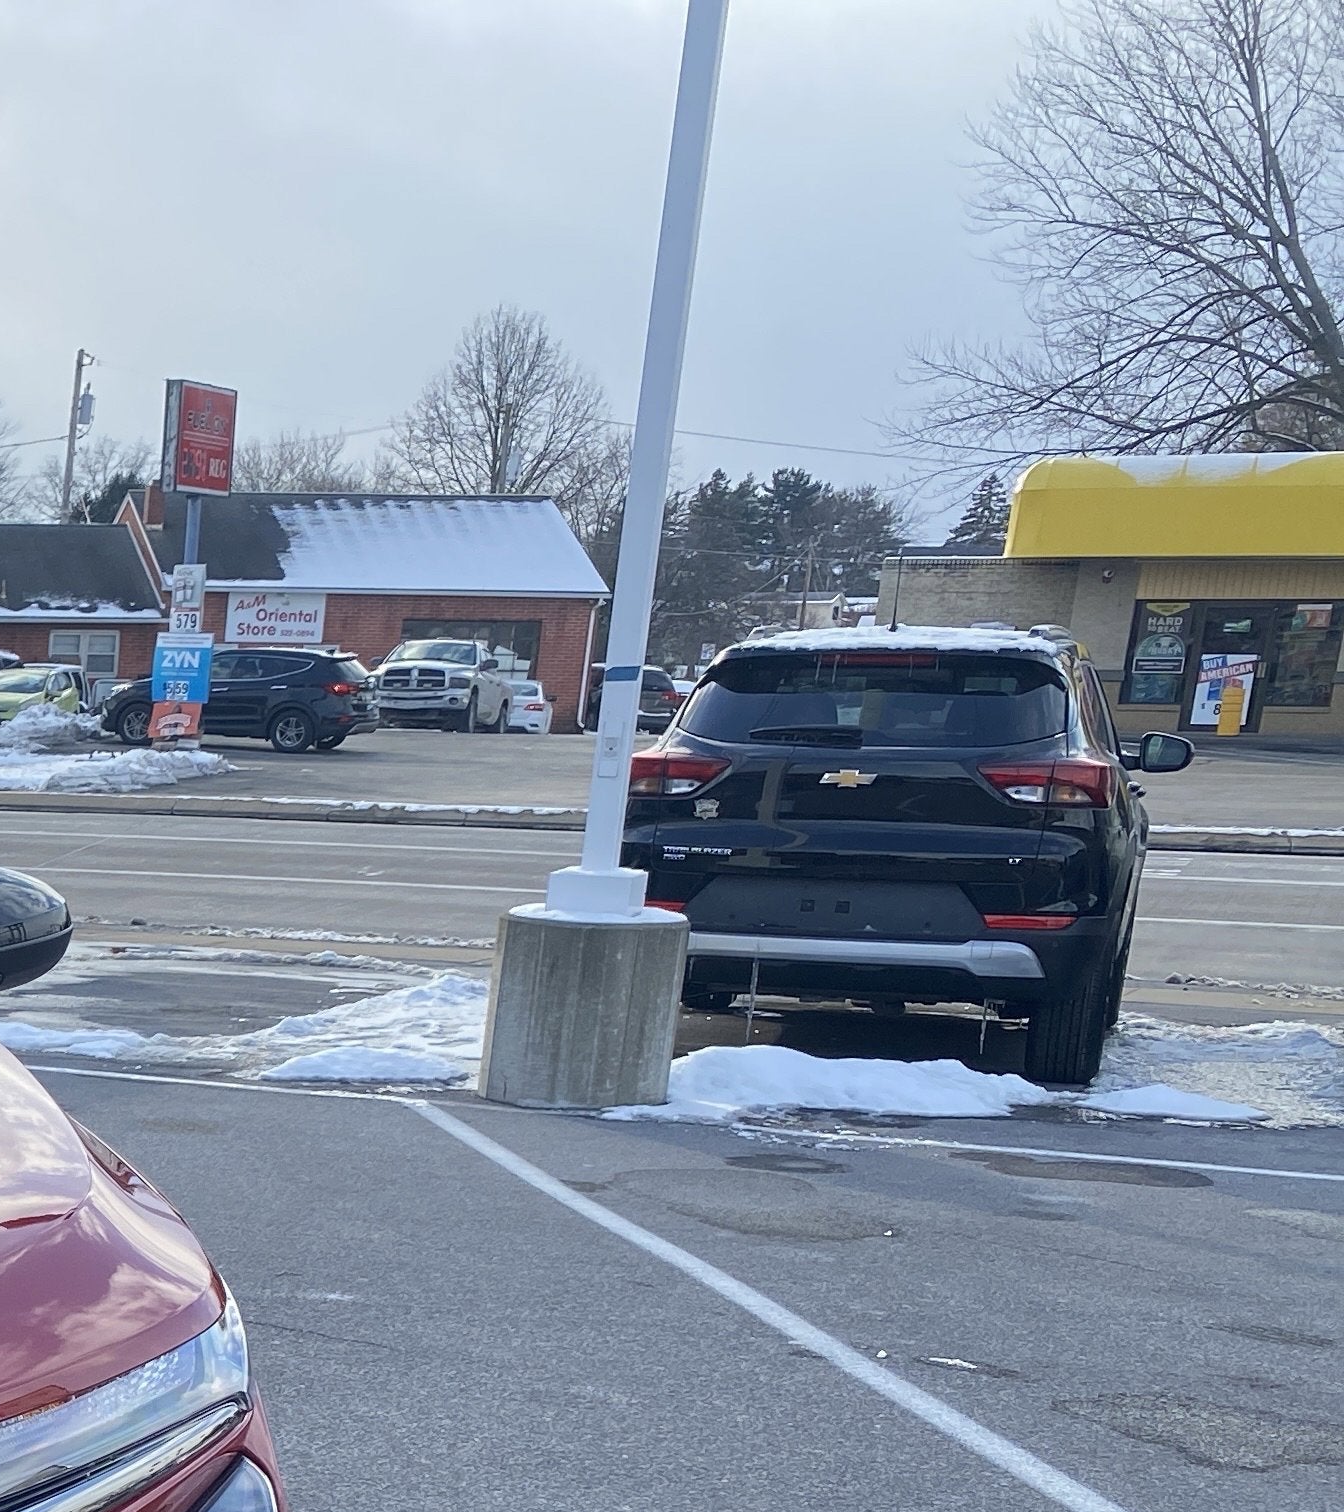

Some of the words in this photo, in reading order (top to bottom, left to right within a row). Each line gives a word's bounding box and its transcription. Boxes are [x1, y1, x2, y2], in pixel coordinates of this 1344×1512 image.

[208, 458, 227, 479] REG
[176, 613, 197, 628] 579
[256, 608, 318, 623] Oriental
[1148, 617, 1183, 626] HARD
[237, 623, 276, 636] Store
[161, 651, 201, 668] ZYN
[1202, 658, 1224, 670] BUY
[1200, 663, 1254, 682] AMERICAN
